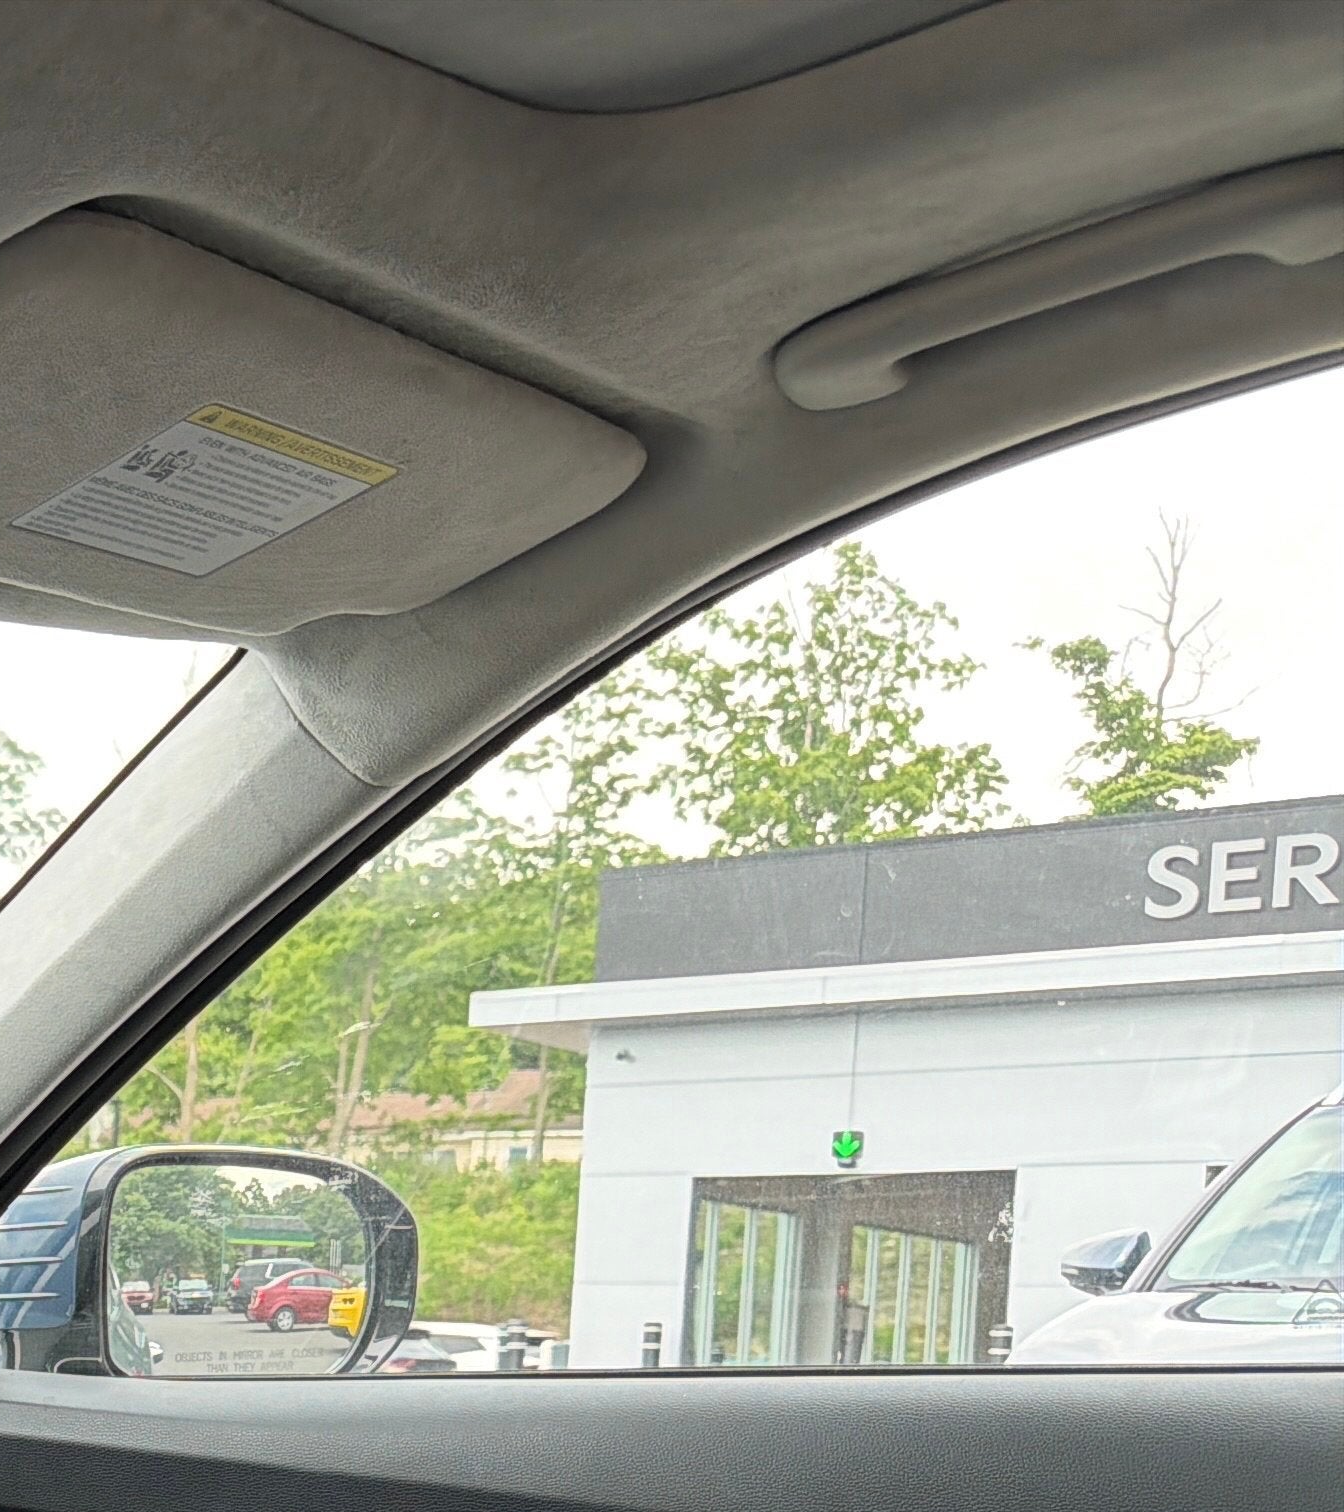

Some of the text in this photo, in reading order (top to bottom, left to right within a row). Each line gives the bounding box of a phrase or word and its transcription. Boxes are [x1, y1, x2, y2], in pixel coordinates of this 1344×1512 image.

[1144, 832, 1340, 919] SER
[175, 1351, 212, 1362] OBJECTS
[218, 1351, 227, 1361] IN
[233, 1350, 263, 1361] MIRROR
[291, 1348, 324, 1359] CLOSER
[207, 1361, 294, 1373] THAN THEY APPEAR
